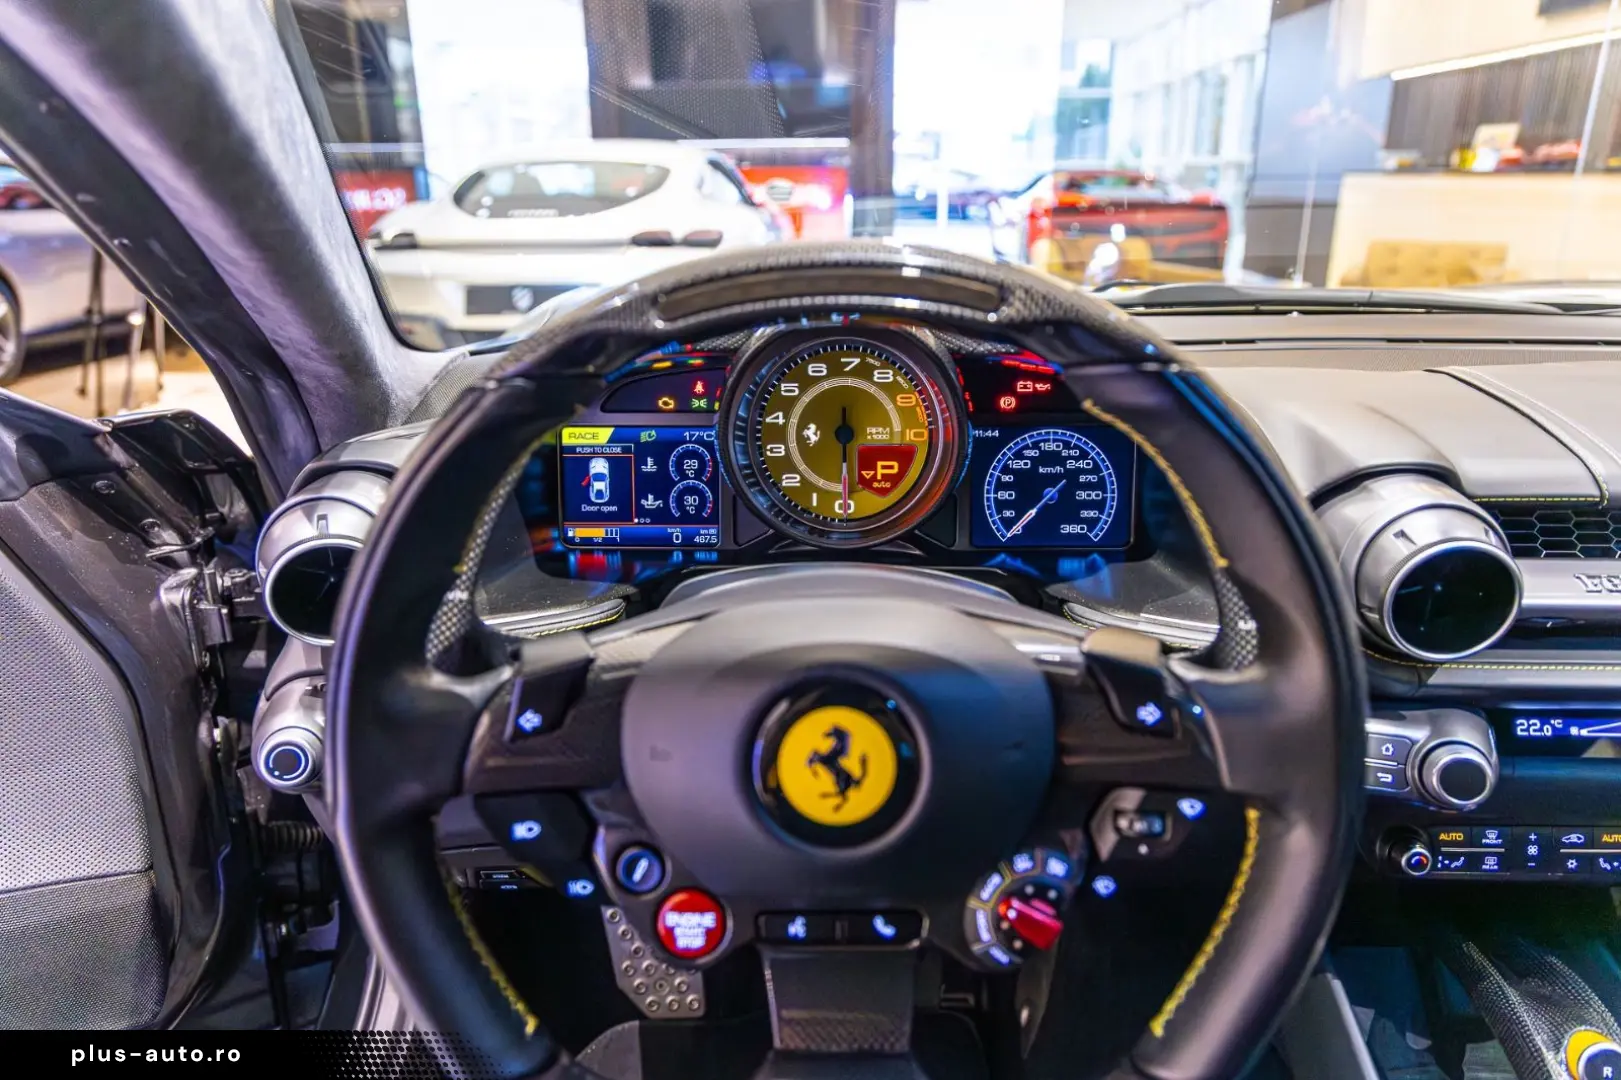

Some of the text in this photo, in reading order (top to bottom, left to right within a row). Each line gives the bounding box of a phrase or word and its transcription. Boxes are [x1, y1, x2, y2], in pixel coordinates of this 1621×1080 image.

[807, 364, 828, 376] 6
[840, 357, 860, 372] 7
[873, 370, 894, 382] 8
[780, 383, 800, 396] 5
[896, 394, 916, 406] 9
[765, 411, 786, 425] 4
[568, 432, 600, 440] RACE
[683, 431, 716, 441] 17°C
[906, 428, 928, 441] 10
[766, 444, 786, 456] 3
[1039, 442, 1062, 450] 180
[684, 460, 698, 470] 29
[1007, 460, 1031, 468] 120
[1038, 466, 1064, 474] km/h
[1066, 460, 1093, 468] 240
[876, 461, 899, 480] P
[782, 474, 801, 487] 2
[684, 496, 699, 506] 30
[812, 492, 818, 506] 1
[1076, 491, 1102, 500] 300
[600, 504, 618, 513] open
[834, 500, 854, 514] 0
[1060, 524, 1087, 534] 360
[673, 532, 682, 544] 0
[1439, 832, 1464, 840] AUTO
[1602, 1066, 1613, 1078] R
